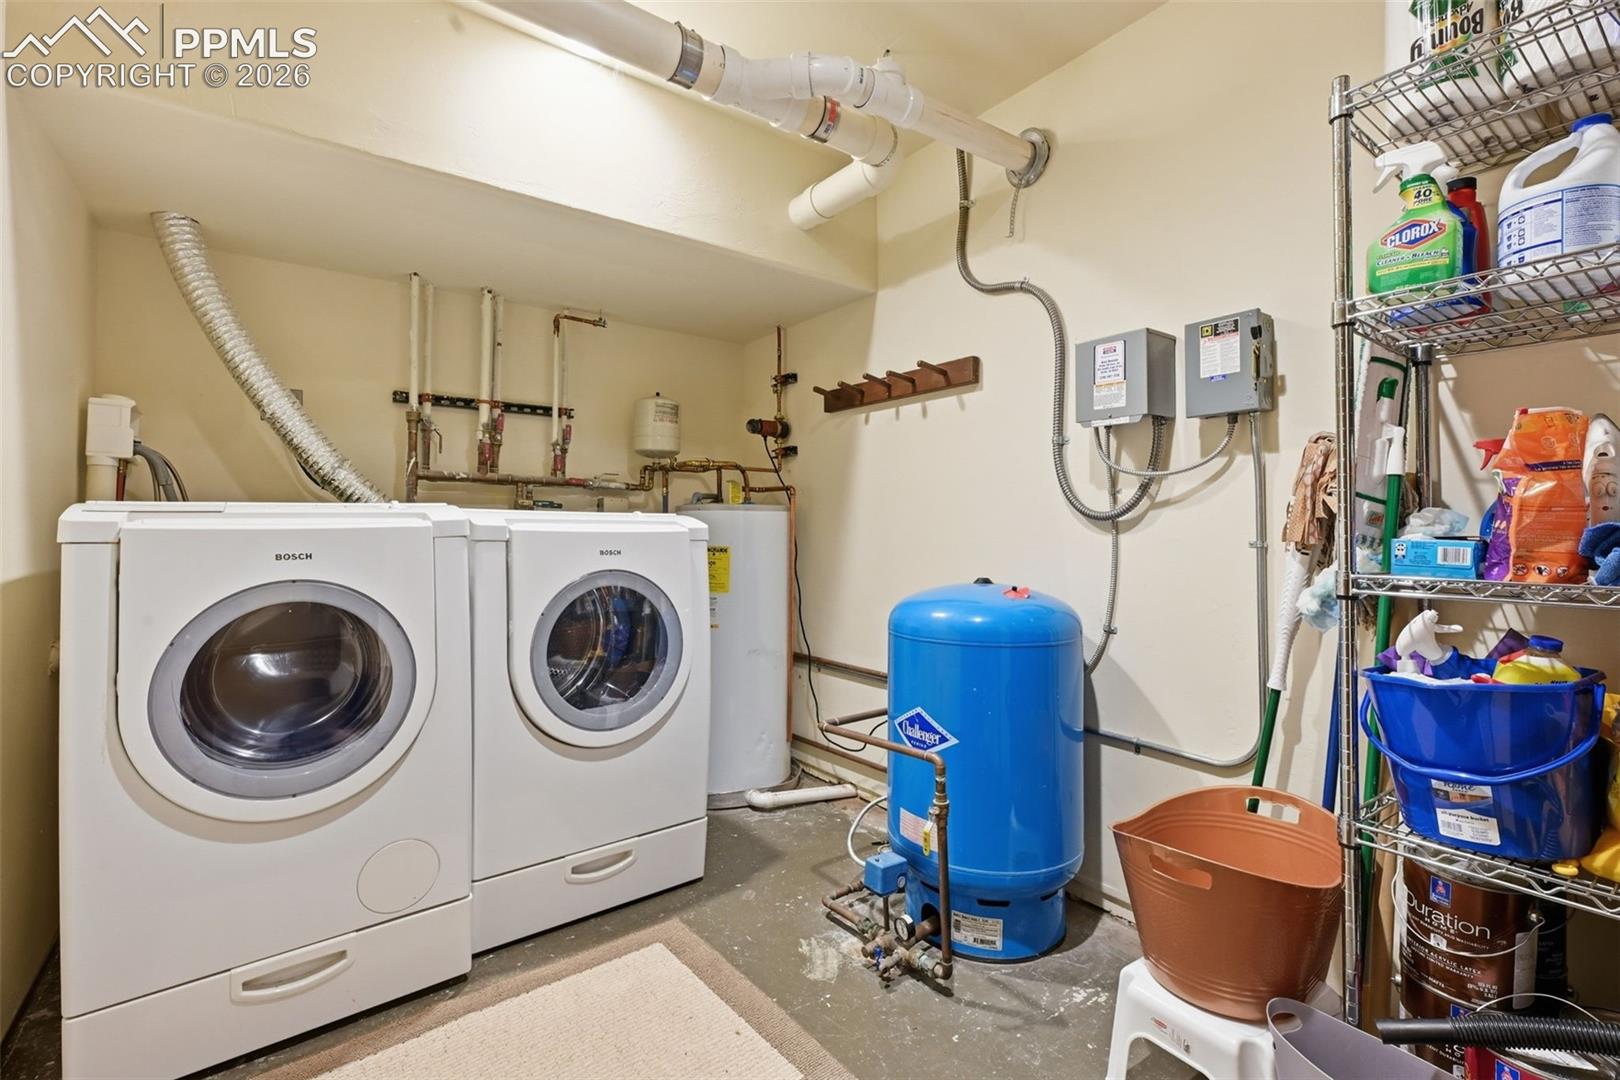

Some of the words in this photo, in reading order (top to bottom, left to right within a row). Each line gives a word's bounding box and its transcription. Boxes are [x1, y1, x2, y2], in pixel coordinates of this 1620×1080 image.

[1410, 8, 1484, 62] Bouny
[1386, 220, 1440, 248] CLOROX
[274, 552, 313, 561] BOSCH
[903, 719, 942, 746] Challenger
[1460, 965, 1481, 975] LATEX
